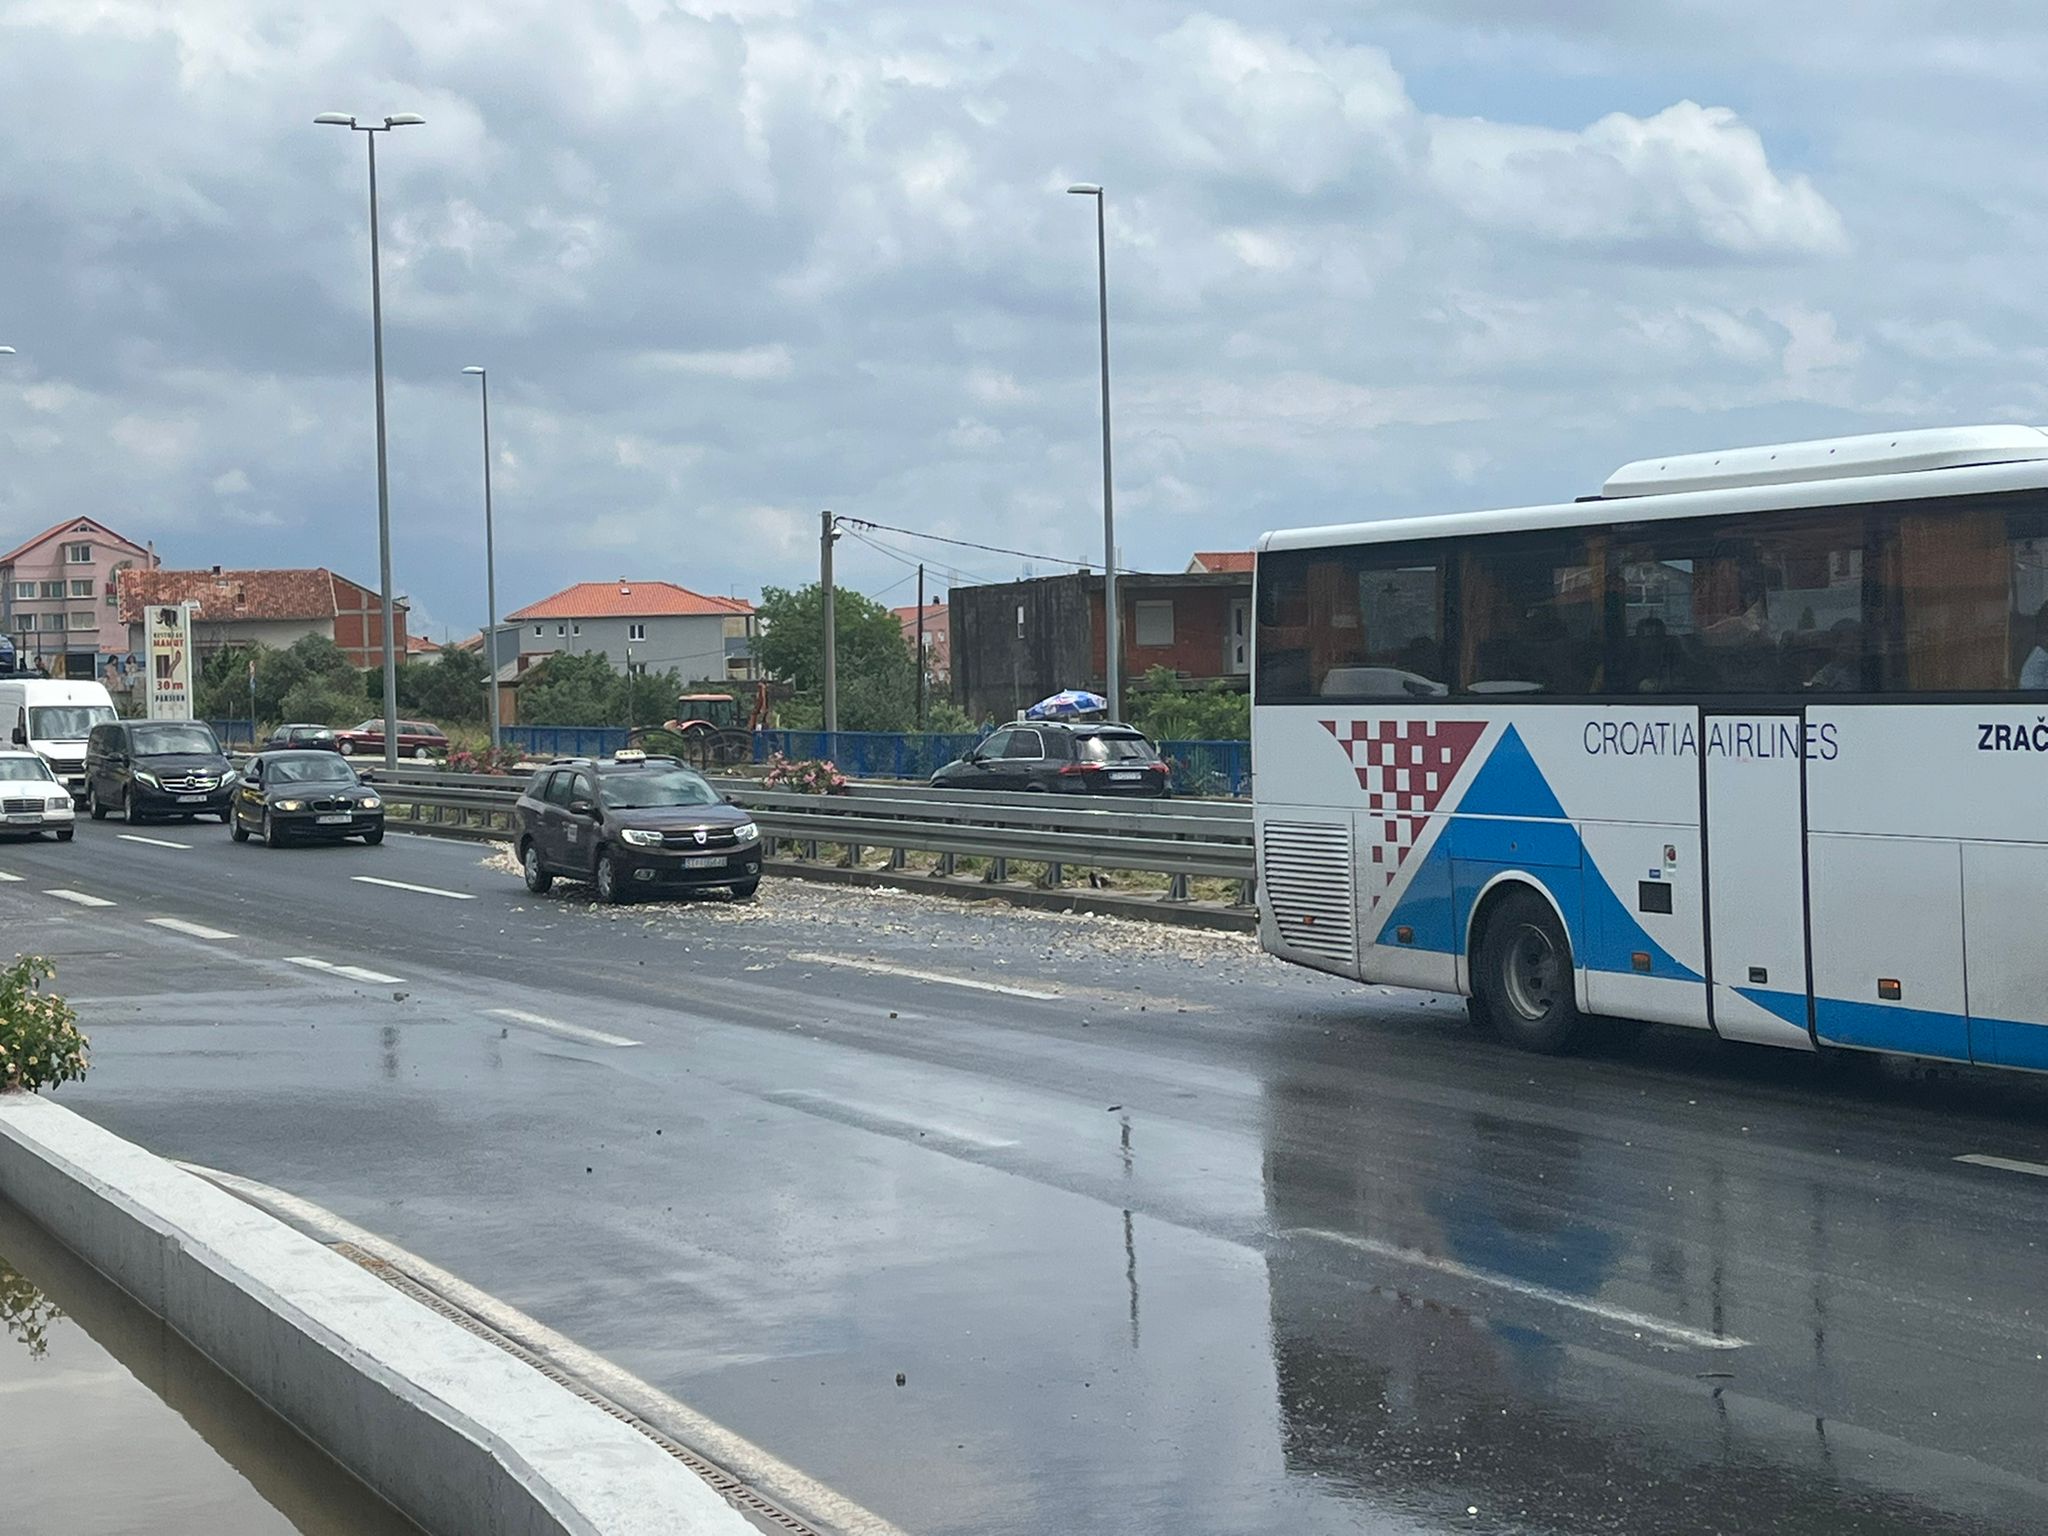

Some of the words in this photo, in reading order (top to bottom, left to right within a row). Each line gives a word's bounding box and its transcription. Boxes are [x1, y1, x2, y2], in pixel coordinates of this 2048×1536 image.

[157, 680, 170, 691] 30
[1583, 721, 1698, 756] CROATIA
[1707, 722, 1839, 761] AIRLINES
[1977, 715, 2048, 752] ZRAČ
